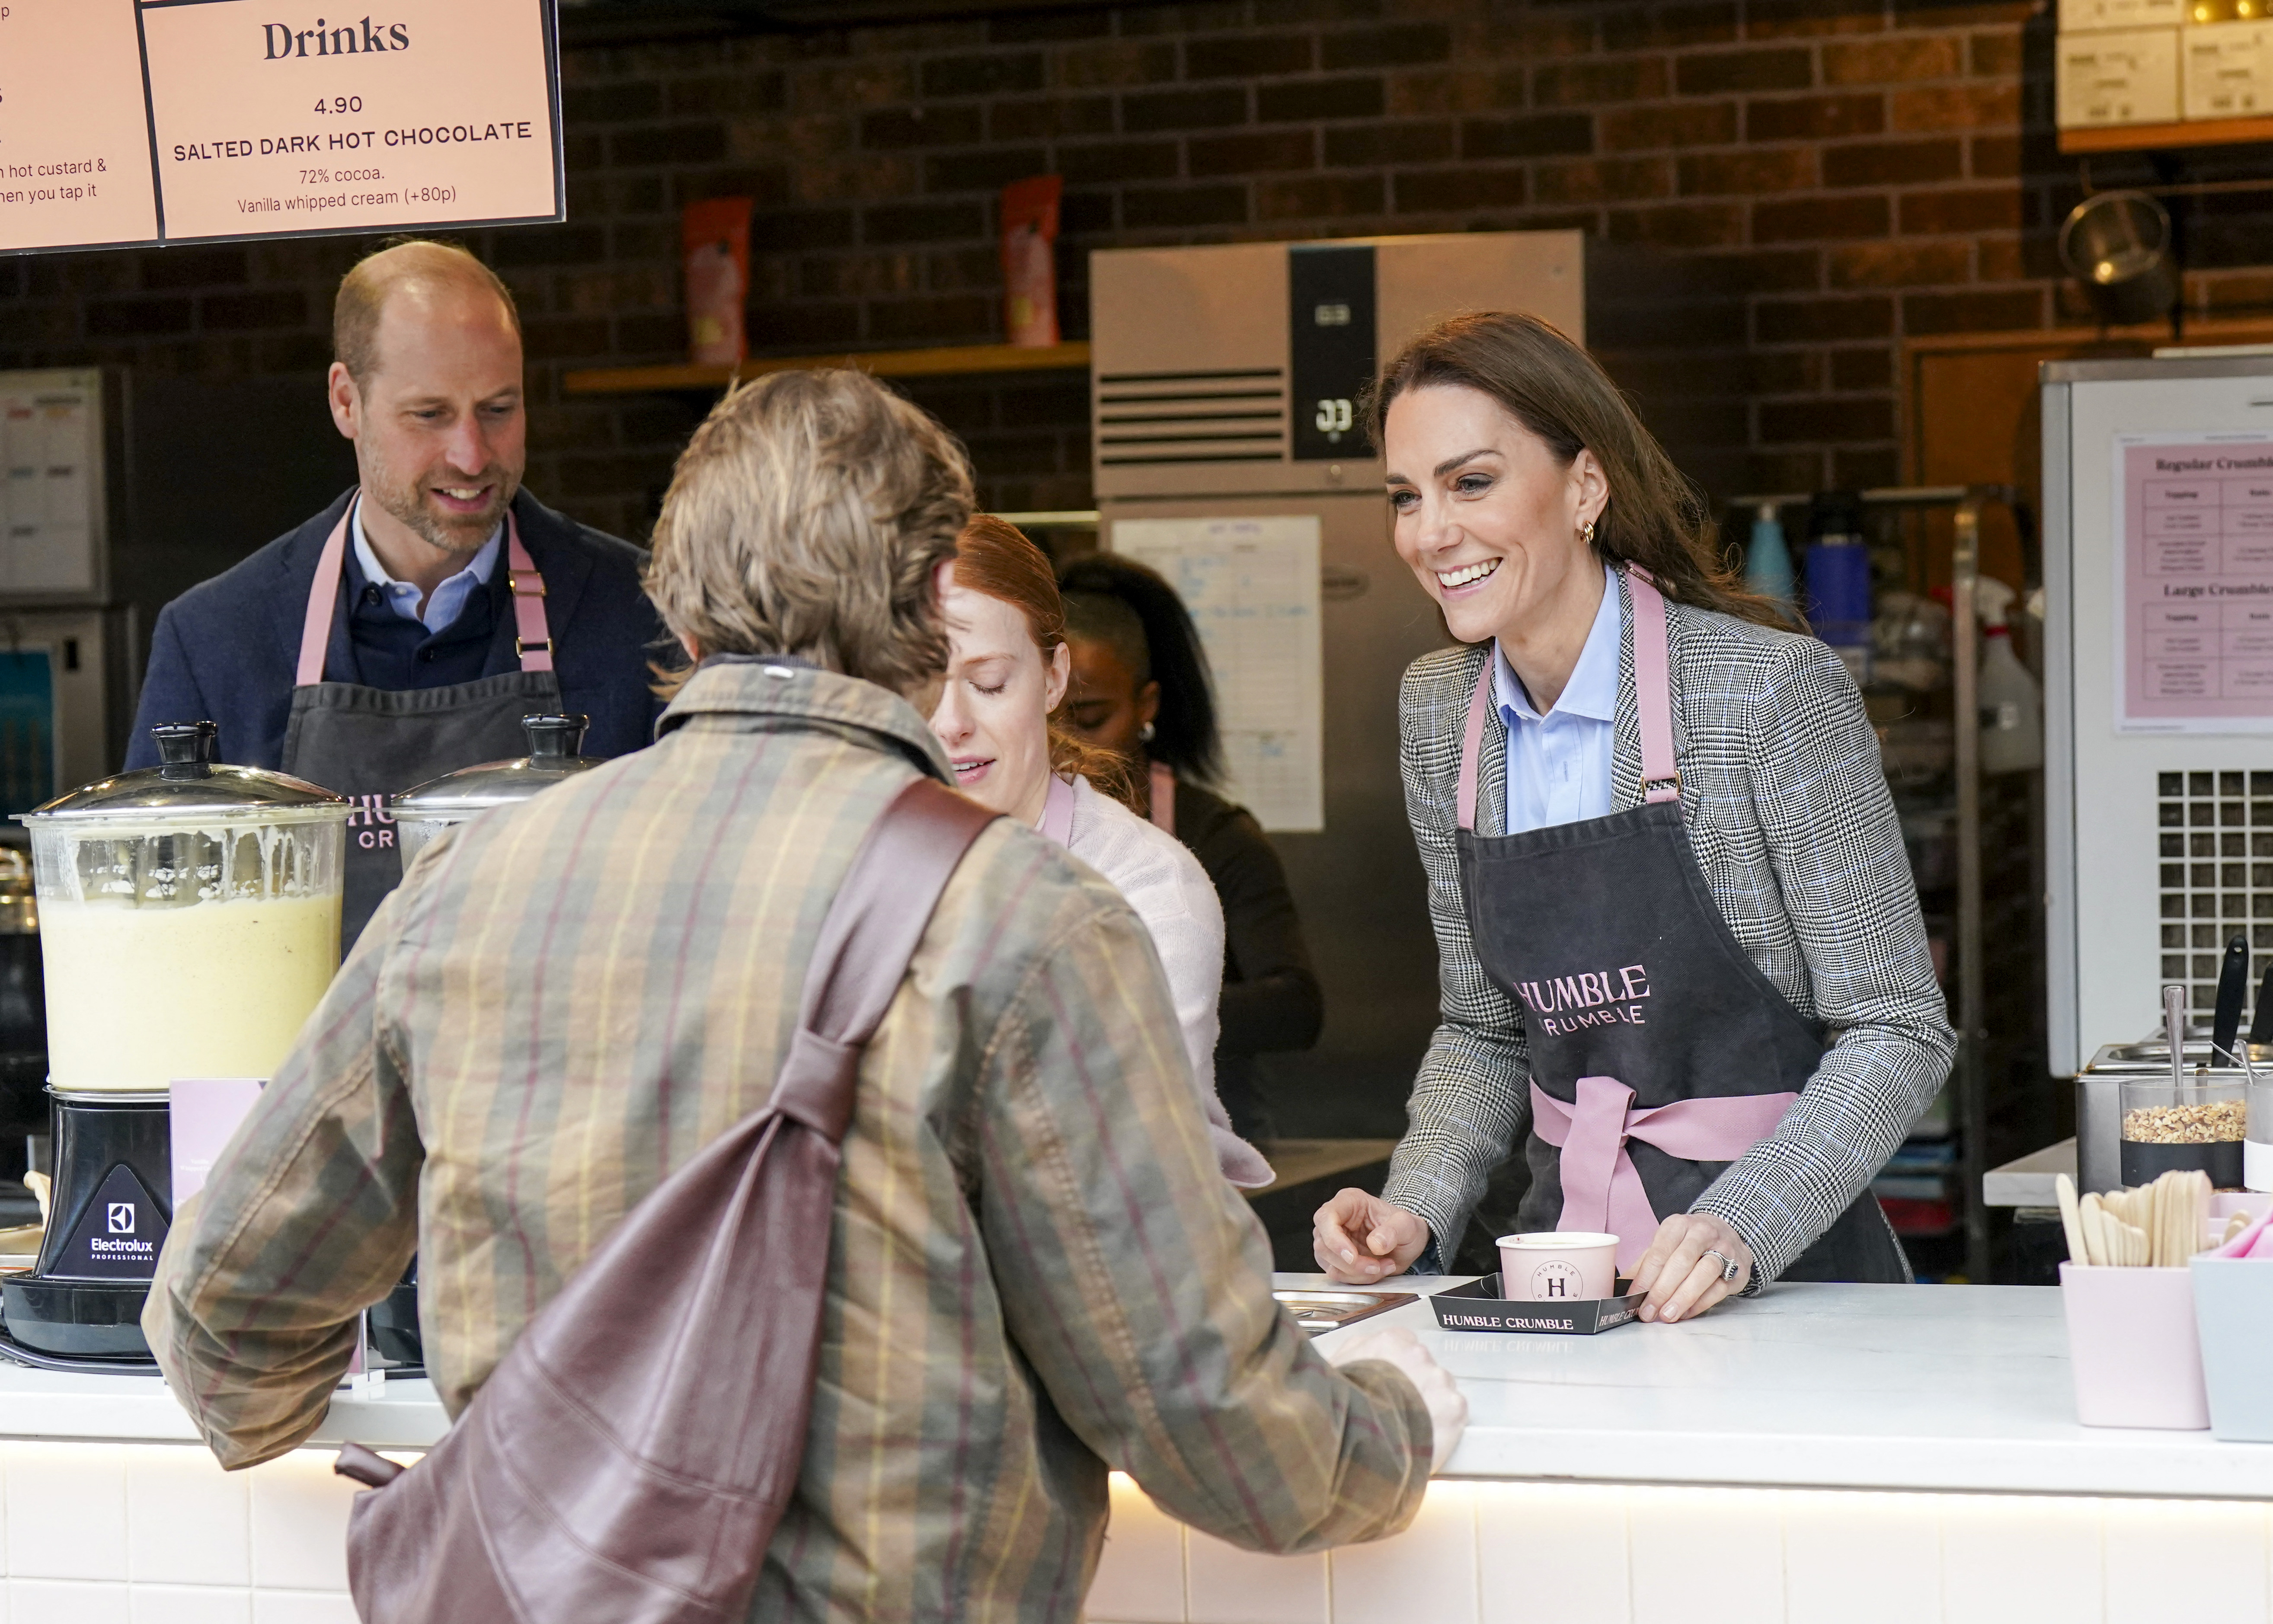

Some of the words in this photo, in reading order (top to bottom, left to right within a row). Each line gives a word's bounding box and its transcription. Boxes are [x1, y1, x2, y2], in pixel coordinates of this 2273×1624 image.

[1, 6, 10, 21] p
[261, 16, 409, 61] Drinks
[314, 96, 362, 115] 4.90
[174, 140, 253, 161] SALTED
[260, 135, 320, 155] DARK
[329, 131, 375, 150] HOT
[384, 121, 532, 146] CHOCOLATE
[9, 164, 33, 178] hot
[38, 159, 92, 176] custard
[97, 158, 107, 172] &
[299, 169, 329, 185] 72%
[335, 169, 385, 182] cocoa.
[28, 189, 55, 205] you
[59, 186, 83, 201] tap
[88, 183, 97, 197] it
[237, 198, 281, 213] Vanilla
[285, 192, 346, 212] whipped
[351, 192, 398, 206] cream
[405, 185, 456, 205] (+80p)
[2216, 457, 2273, 470] Crumbl
[348, 793, 396, 826] HU
[358, 829, 393, 849] CR
[1513, 964, 1650, 1013] HUMBLE
[1538, 1005, 1646, 1036] RUMBLE
[91, 1238, 153, 1252] Electrolux
[1537, 1264, 1576, 1277] HUMBLE
[1547, 1278, 1566, 1297] H
[1442, 1314, 1502, 1327] HUMBLE
[1506, 1317, 1574, 1330] CRUMBLE
